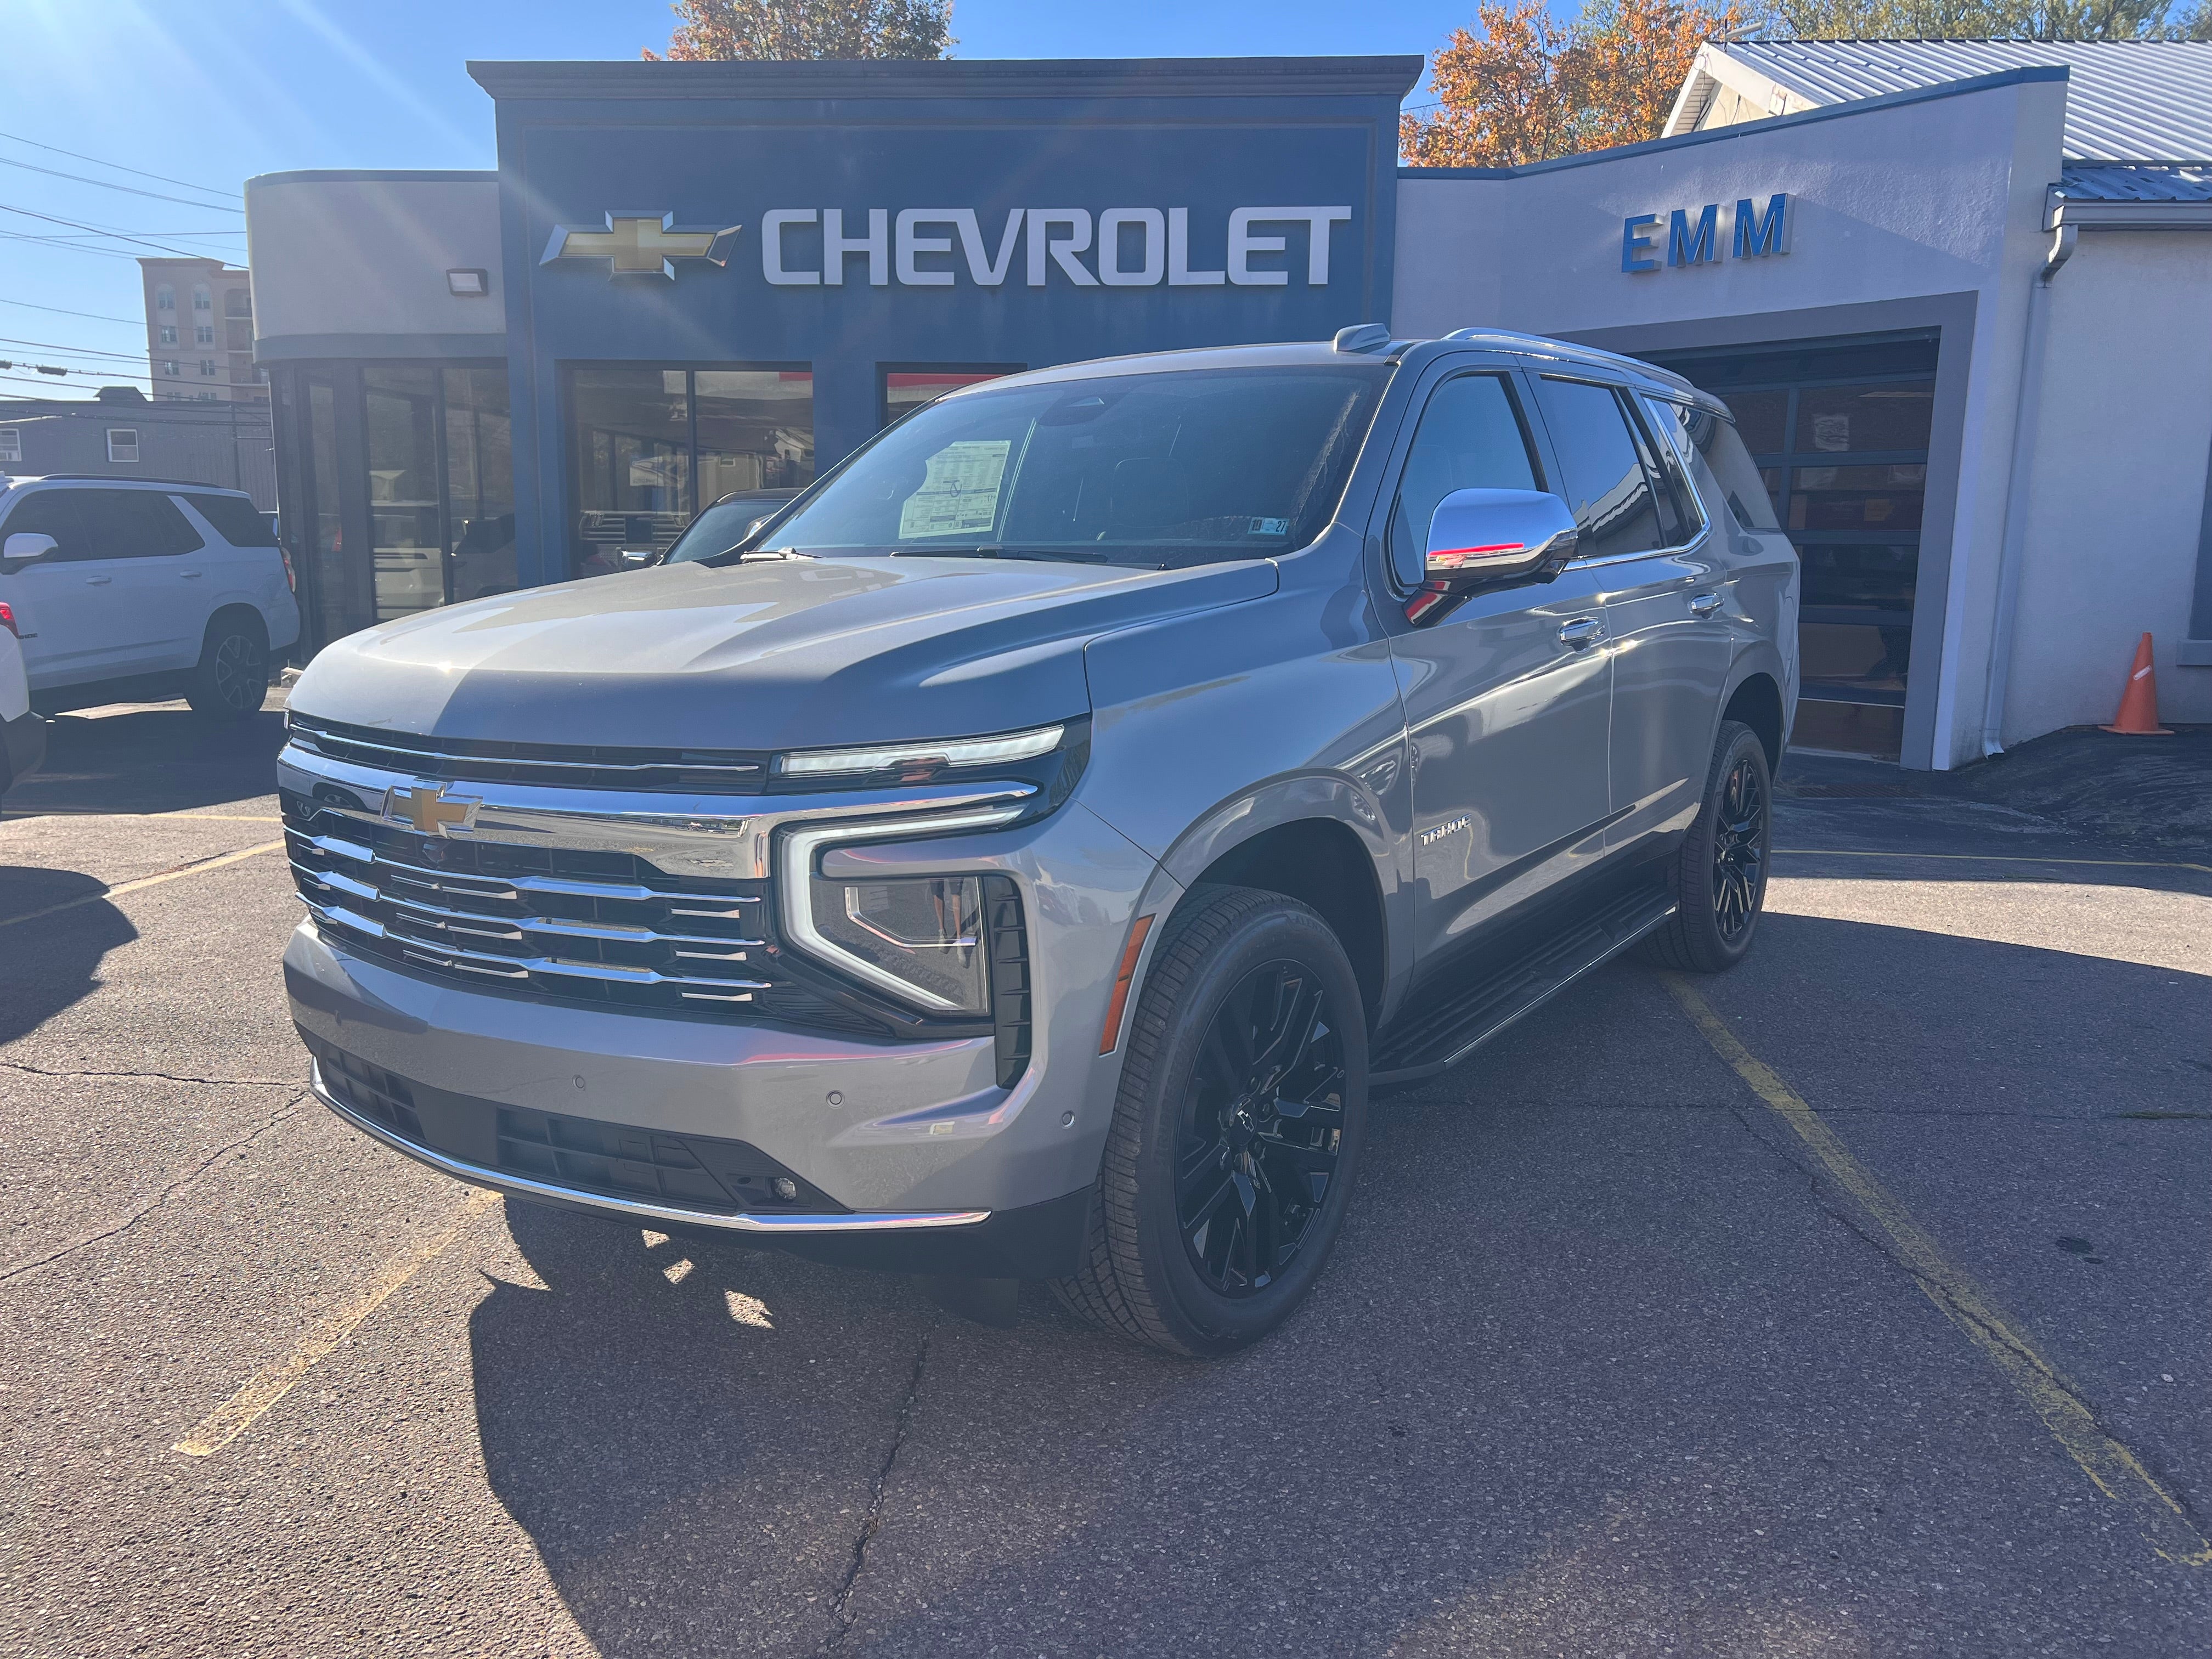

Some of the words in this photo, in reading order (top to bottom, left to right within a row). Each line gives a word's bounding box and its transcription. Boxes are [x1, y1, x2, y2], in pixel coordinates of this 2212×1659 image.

[761, 205, 1351, 286] CHEVROLET
[1621, 193, 1795, 273] EMM
[1276, 520, 1286, 532] 27
[1420, 814, 1471, 846] TAHOE
